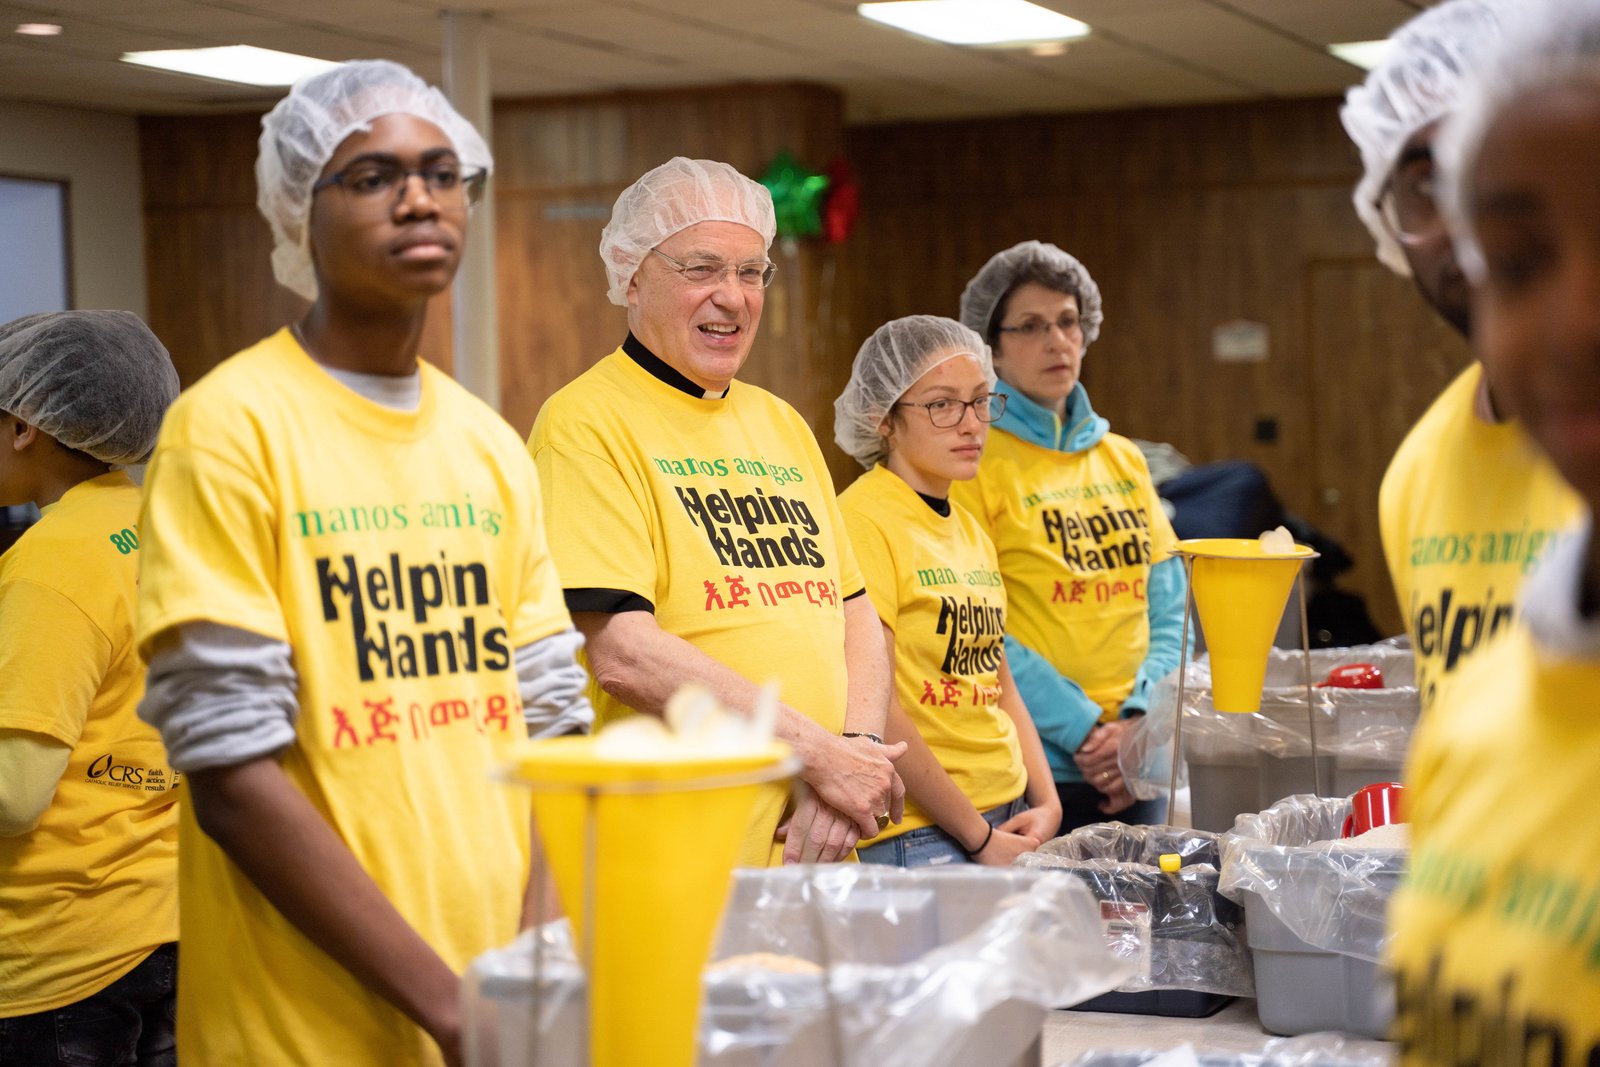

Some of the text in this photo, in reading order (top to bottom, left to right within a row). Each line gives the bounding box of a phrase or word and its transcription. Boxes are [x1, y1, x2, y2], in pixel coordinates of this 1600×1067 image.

[652, 456, 804, 487] manos amigas
[292, 493, 502, 538] manos amias
[674, 486, 820, 536] Helping
[703, 527, 826, 569] Hands
[315, 551, 503, 623] Helpin
[917, 567, 961, 587] man
[352, 610, 511, 683] Hands
[109, 765, 144, 785] CRS
